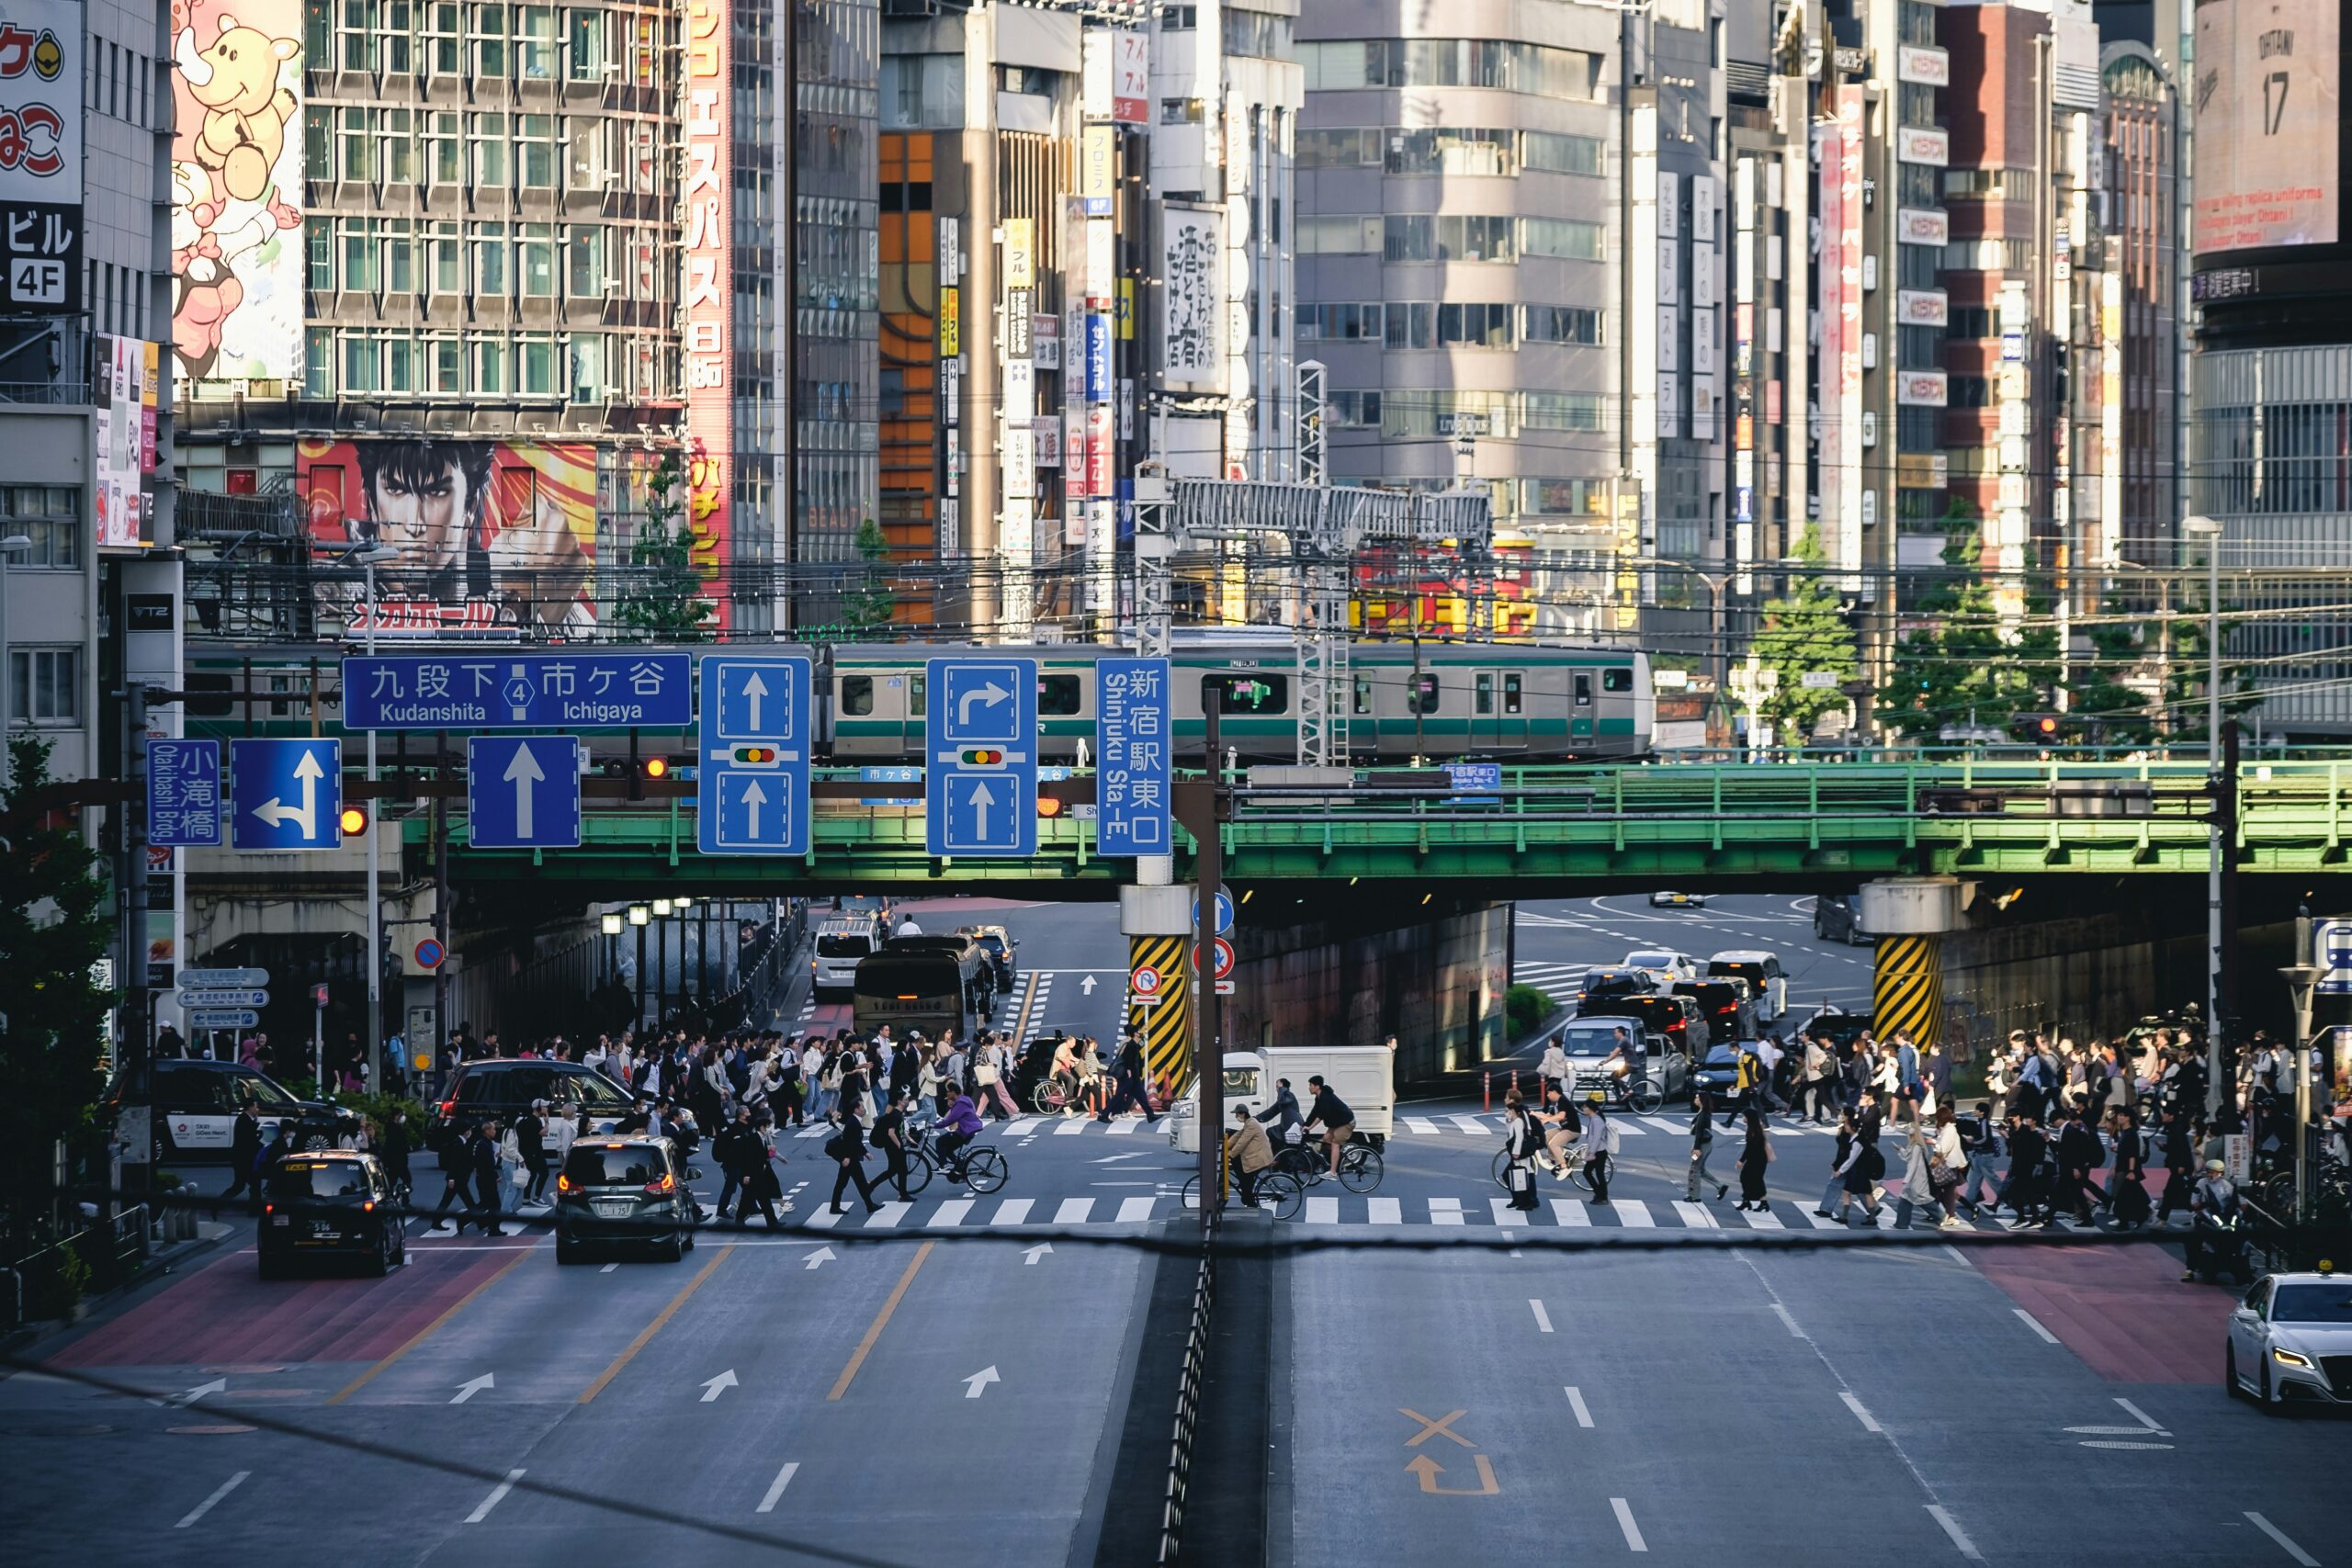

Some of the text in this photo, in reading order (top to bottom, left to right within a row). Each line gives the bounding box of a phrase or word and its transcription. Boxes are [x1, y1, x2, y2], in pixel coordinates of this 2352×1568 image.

[2258, 29, 2294, 61] OHTANI
[2263, 72, 2290, 136] 17
[2275, 186, 2324, 203] uniforms
[8, 210, 73, 255] ビル
[690, 88, 722, 389] エスパス日拓
[17, 265, 61, 297] 4F
[370, 664, 496, 699] 九段下
[512, 683, 526, 703] 4
[379, 701, 642, 723] Kudanshita Ichigaya
[154, 745, 179, 808] Otakibashi
[1102, 672, 1128, 840] Shinjuku Sta.-E.
[1129, 668, 1161, 843] 新宿駅東口
[181, 747, 215, 839] 小滝橋
[151, 810, 179, 842] Brdg.
